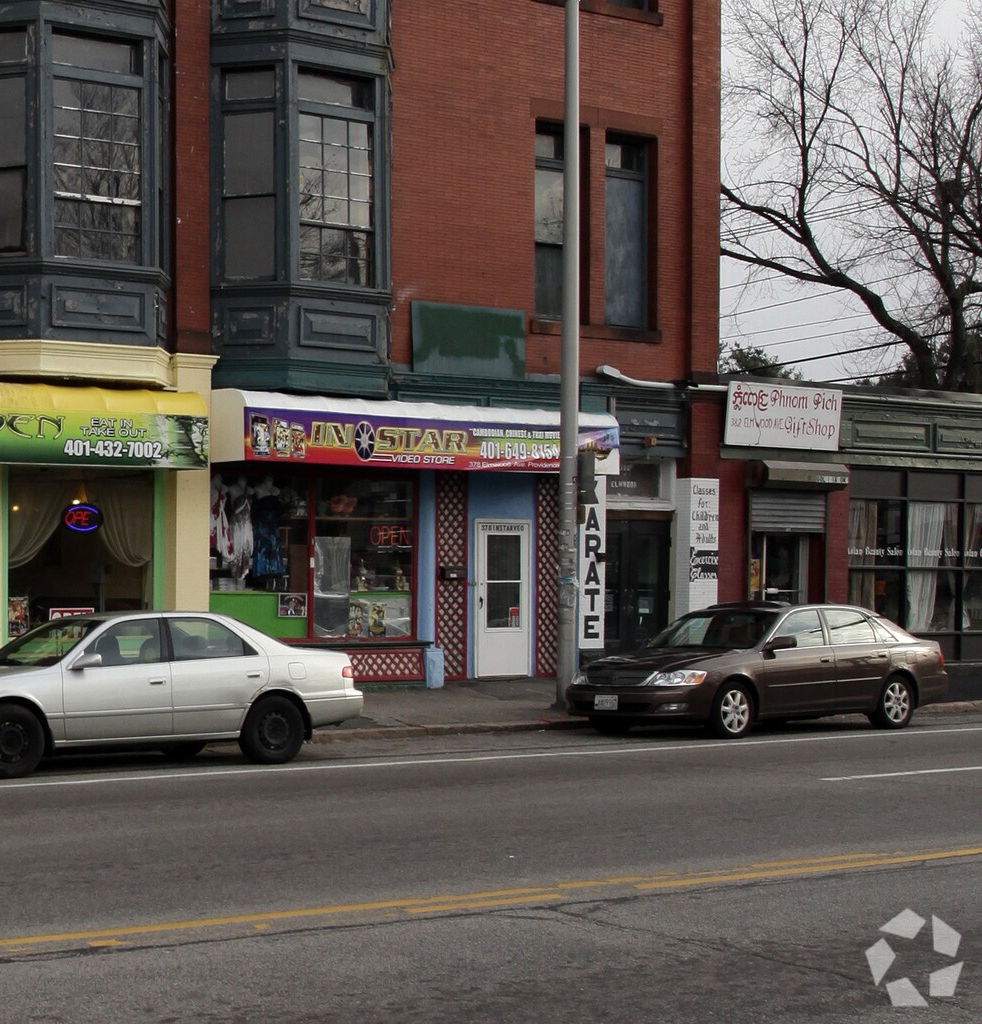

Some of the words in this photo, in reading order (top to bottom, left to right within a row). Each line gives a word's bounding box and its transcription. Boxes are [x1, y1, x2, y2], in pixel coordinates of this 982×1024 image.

[770, 390, 808, 410] Phnom
[813, 393, 837, 411] Pich
[91, 417, 117, 427] EAT
[120, 419, 133, 428] IN
[806, 418, 835, 439] Shop
[81, 427, 115, 437] TAKE
[118, 428, 147, 438] OUT
[311, 421, 354, 448] IN
[376, 426, 469, 453] STAR
[64, 439, 163, 458] 401-432-7002
[480, 441, 560, 460] 401-649-8154
[392, 455, 421, 464] VIDEO
[423, 456, 455, 465] STORE
[692, 484, 716, 495] Classes
[370, 525, 410, 546] OPEN
[865, 546, 885, 558] Beauty
[887, 546, 904, 557] Salon
